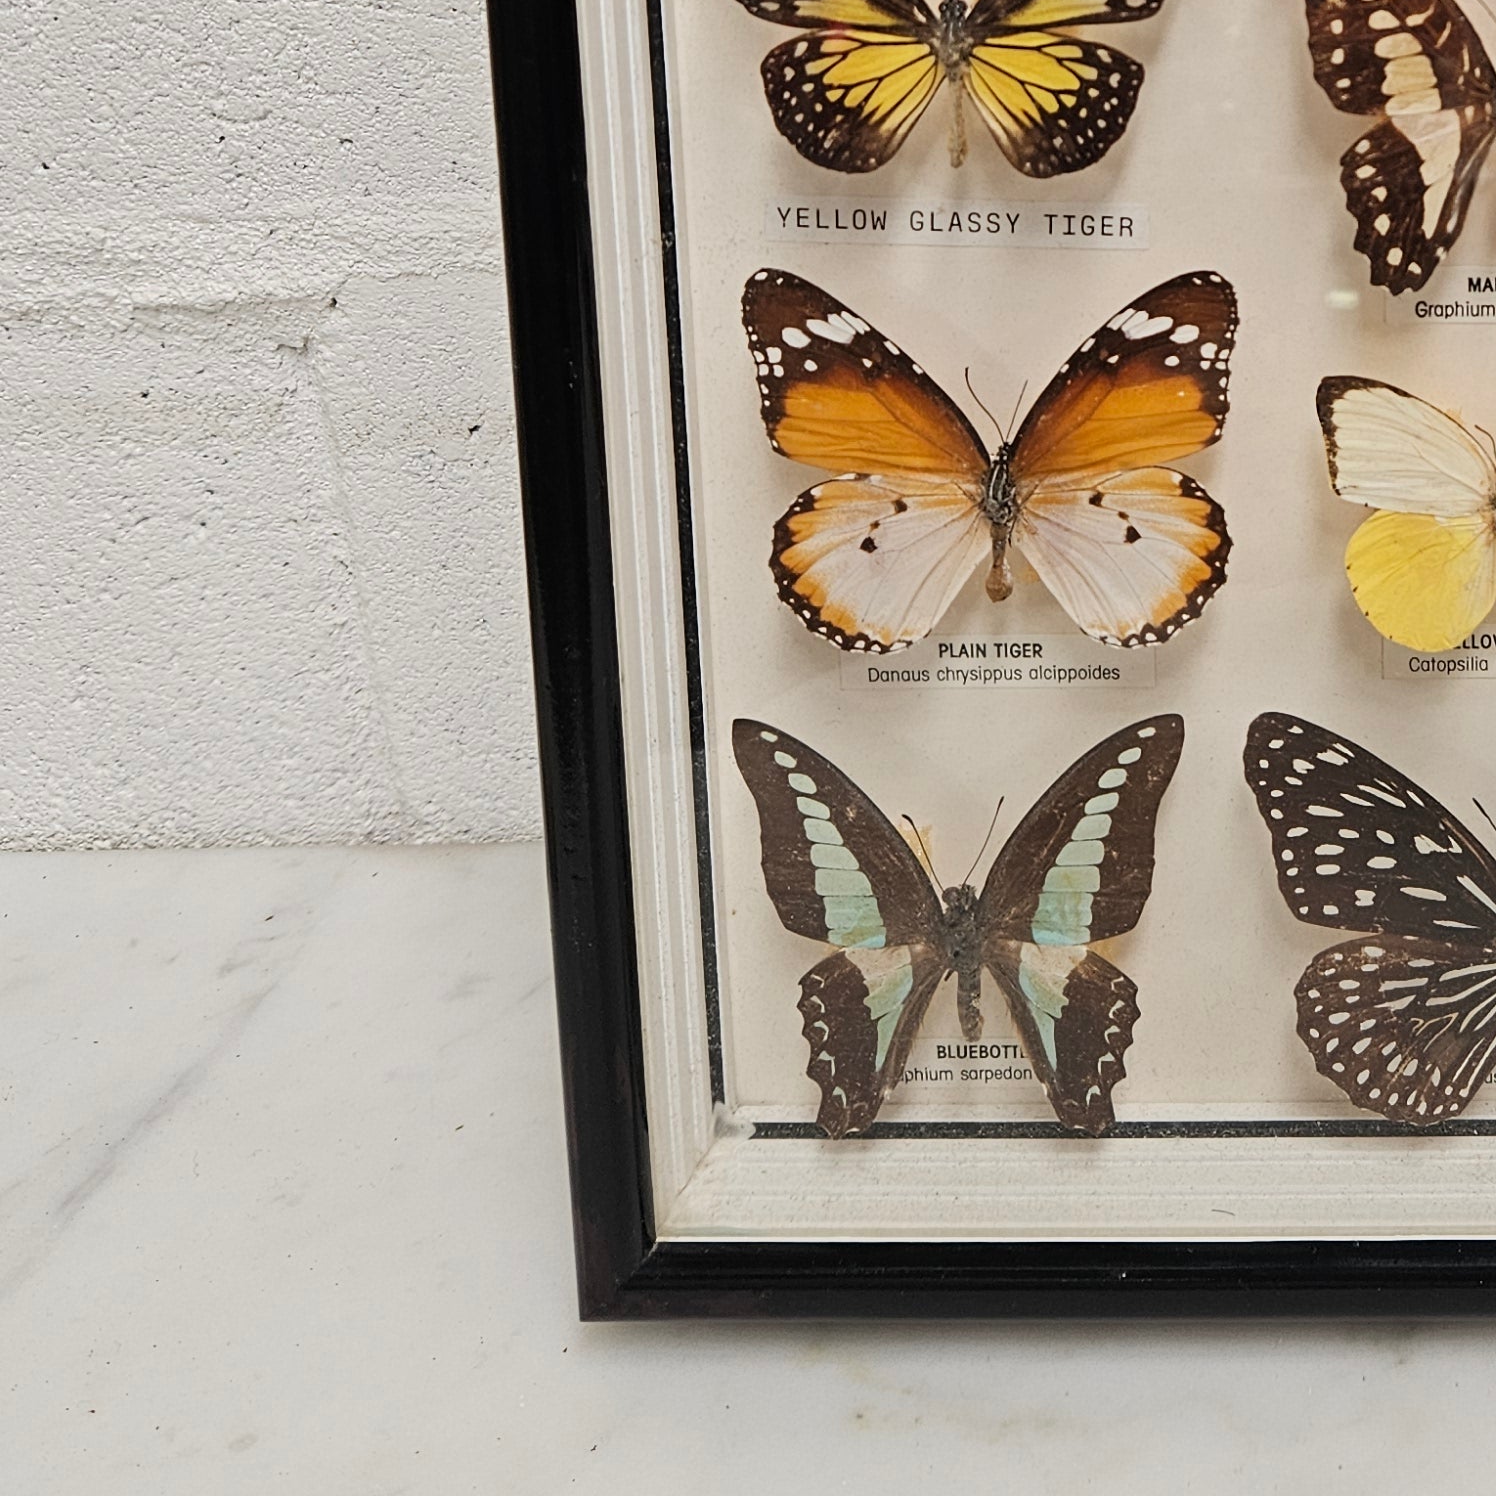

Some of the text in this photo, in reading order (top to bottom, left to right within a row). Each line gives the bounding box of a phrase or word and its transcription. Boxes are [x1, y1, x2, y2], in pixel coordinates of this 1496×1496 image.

[777, 207, 1134, 237] YELLOW GLASSY TIGER
[1415, 301, 1495, 319] Graphium
[938, 643, 1043, 658] PLAIN TIGER
[1409, 655, 1489, 675] Catopsilia
[868, 665, 1120, 685] Danaus chrysippus alcippoides
[936, 1045, 1029, 1059] BLUEBOTTL
[902, 1067, 1032, 1084] phium sarpedon
